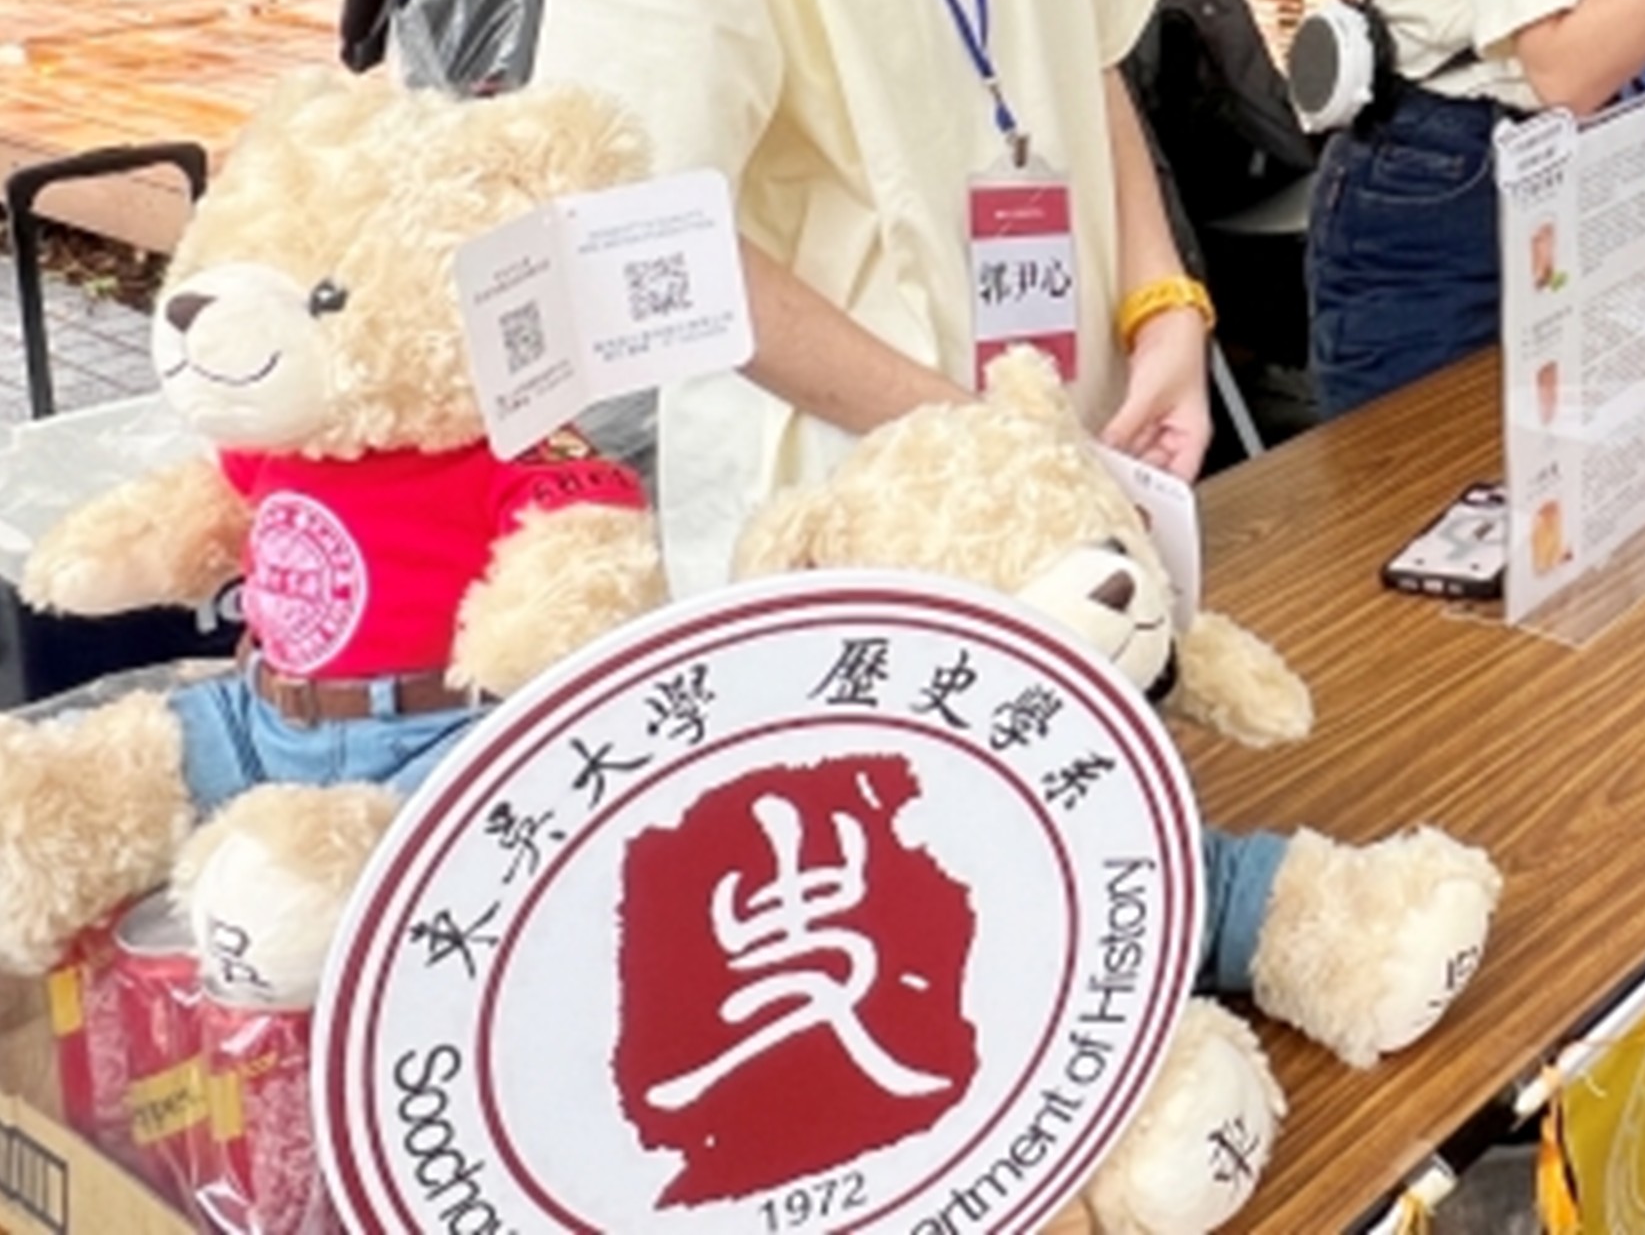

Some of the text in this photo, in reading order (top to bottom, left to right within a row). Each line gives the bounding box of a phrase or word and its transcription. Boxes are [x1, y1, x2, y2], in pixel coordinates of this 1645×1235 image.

[408, 637, 1116, 978] 東吳大學 歷史學系
[1079, 856, 1157, 1024] History
[1065, 1032, 1113, 1088] of
[758, 1171, 868, 1232] 1972
